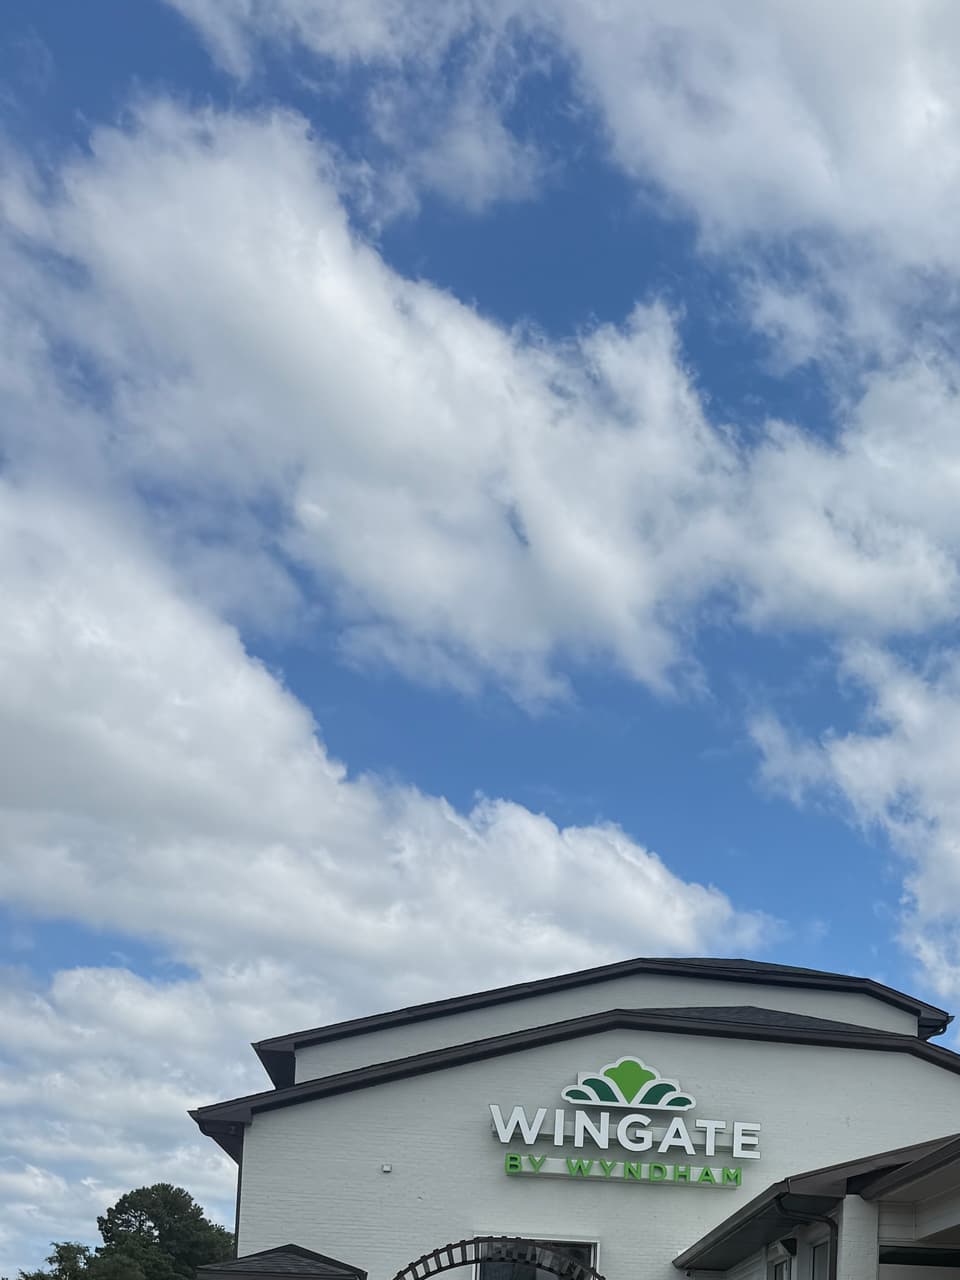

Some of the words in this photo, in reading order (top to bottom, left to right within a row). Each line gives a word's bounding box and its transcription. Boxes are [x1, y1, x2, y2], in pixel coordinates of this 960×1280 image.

[488, 1103, 762, 1160] WINGATE
[504, 1152, 546, 1175] BY
[566, 1156, 743, 1187] WYNDHAM
